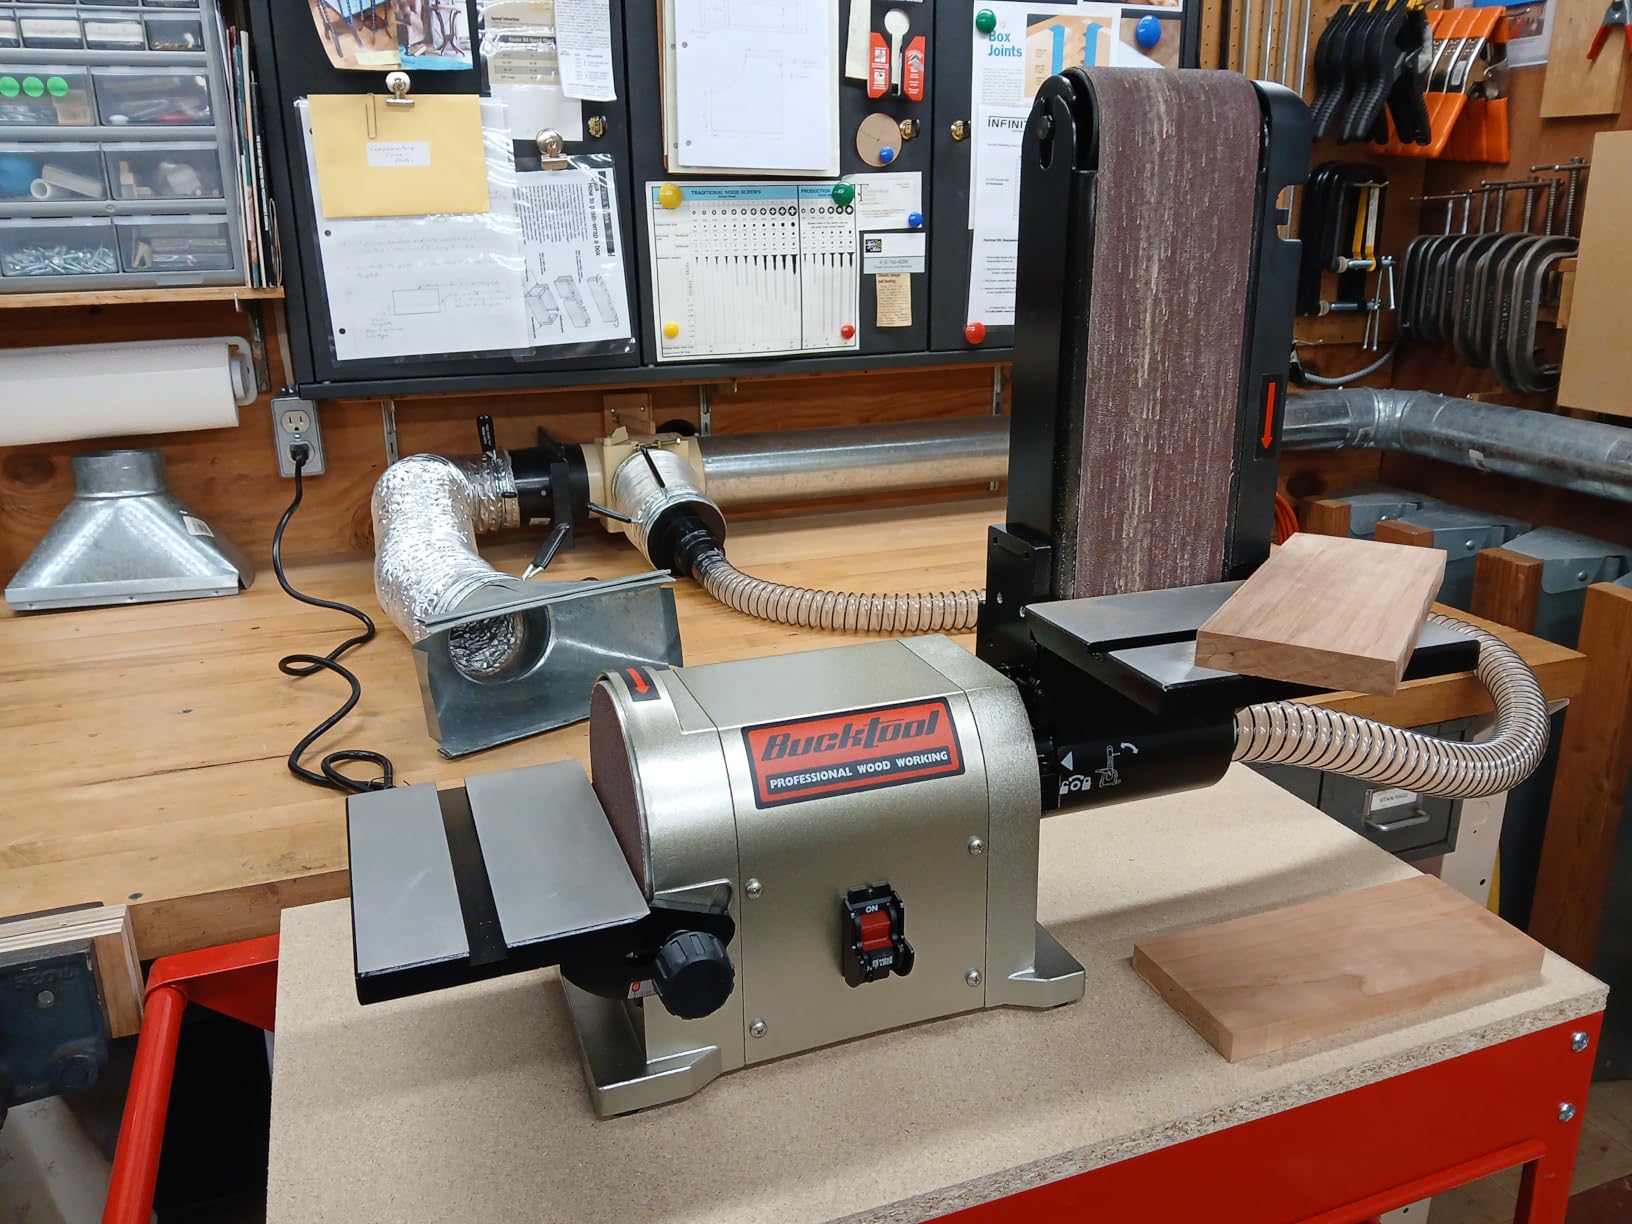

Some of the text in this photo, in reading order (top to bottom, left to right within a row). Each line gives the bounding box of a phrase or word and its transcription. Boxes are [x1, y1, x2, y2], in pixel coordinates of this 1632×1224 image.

[988, 30, 1011, 43] Box
[988, 44, 1023, 57] Joints
[589, 205, 599, 239] gain-wrap
[761, 709, 940, 762] Bucktool
[769, 751, 948, 790] PROFESSIONAL WOOD WORKING
[865, 904, 879, 913] ON
